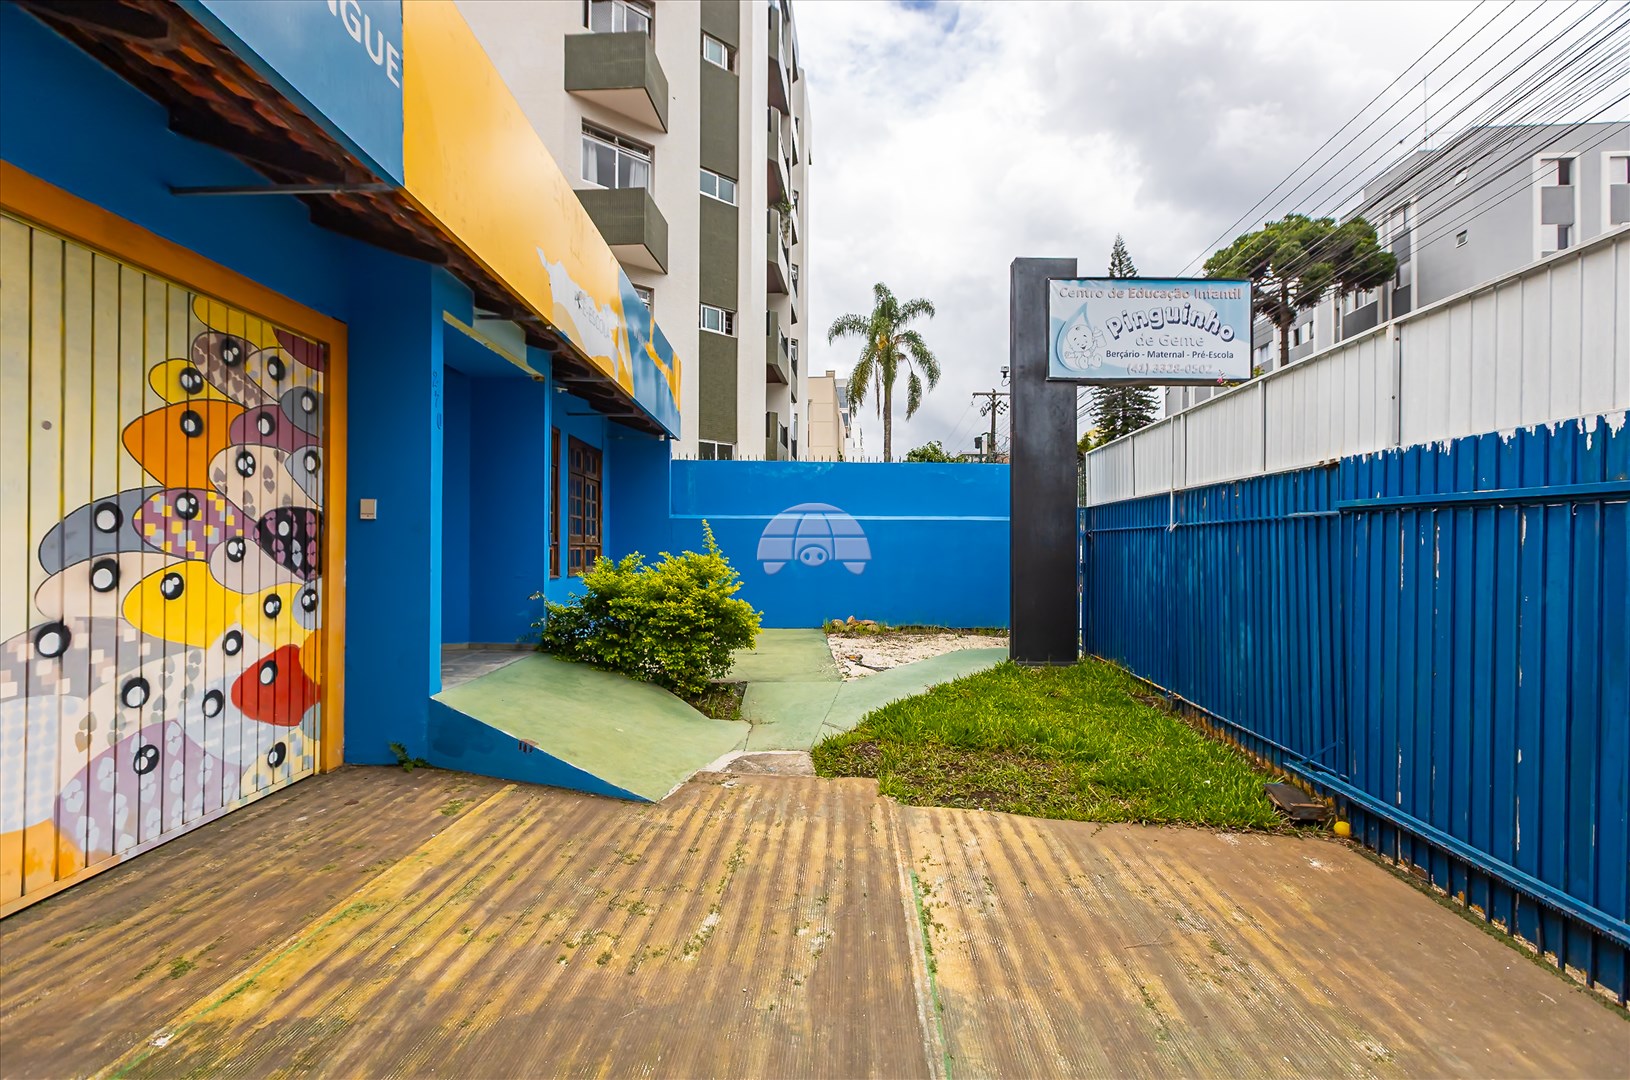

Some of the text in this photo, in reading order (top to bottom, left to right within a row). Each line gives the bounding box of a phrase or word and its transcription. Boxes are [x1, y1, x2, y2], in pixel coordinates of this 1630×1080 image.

[1059, 287, 1242, 301] Centro de Educação Infantil
[1105, 302, 1235, 342] Pinguinho
[1135, 333, 1153, 347] de
[1105, 350, 1140, 360] Berçário
[1147, 350, 1185, 359] Maternal
[1192, 349, 1234, 359] Pré-Escola
